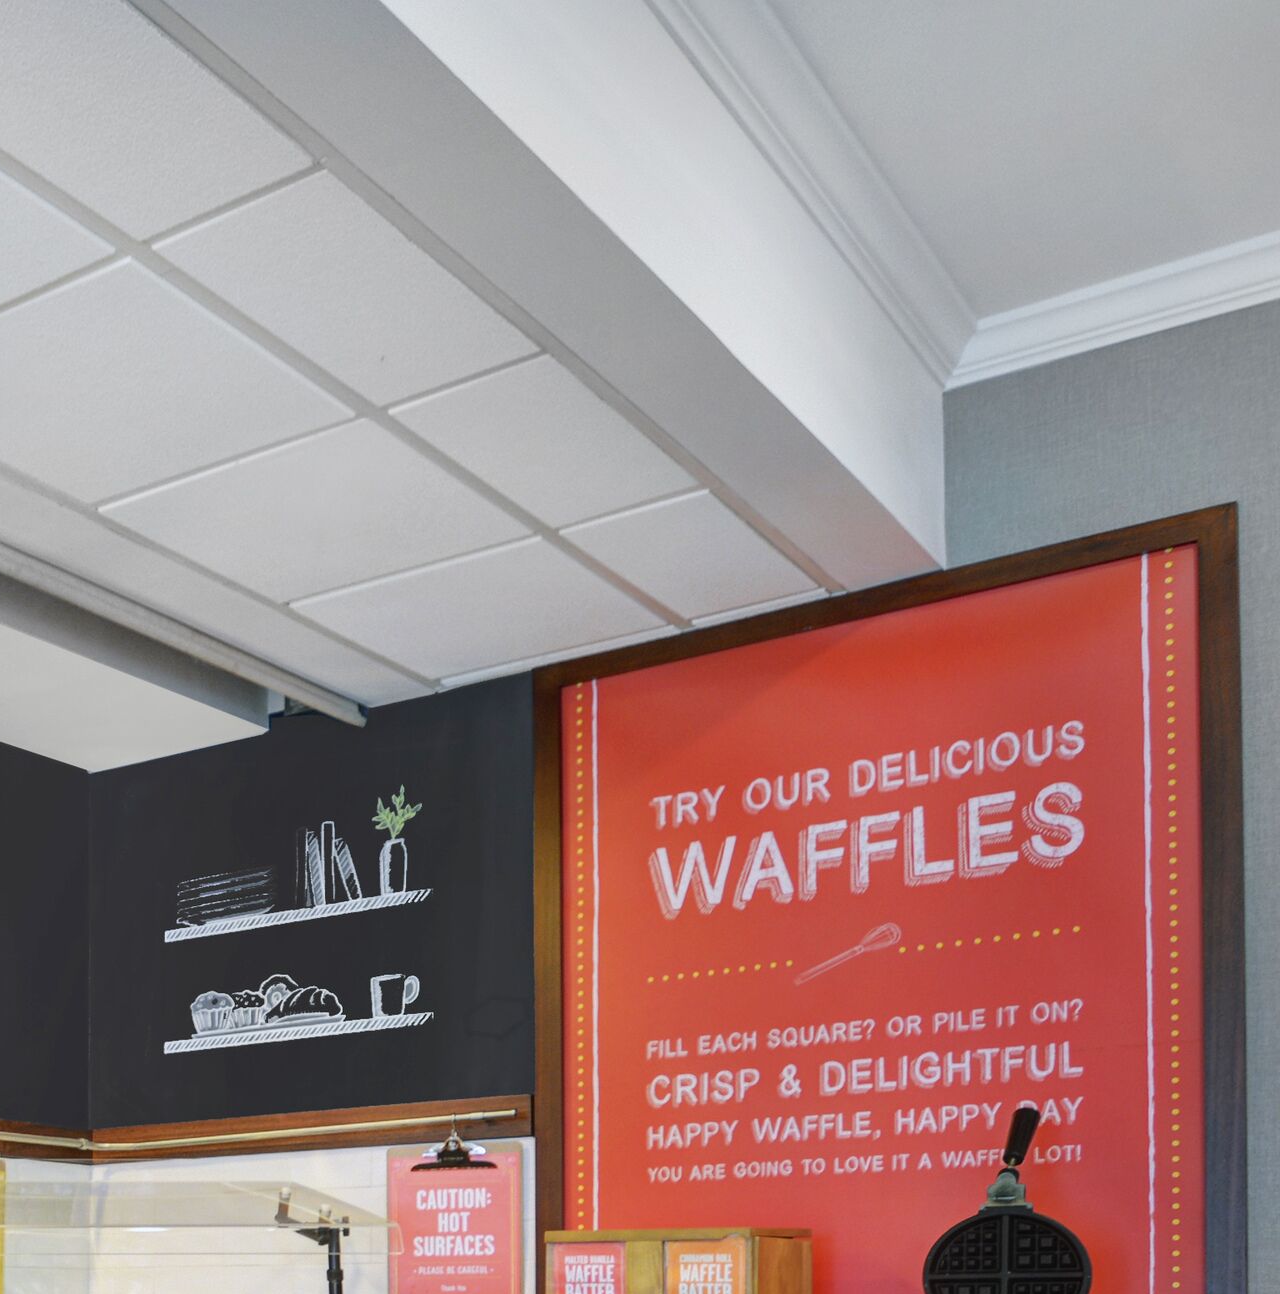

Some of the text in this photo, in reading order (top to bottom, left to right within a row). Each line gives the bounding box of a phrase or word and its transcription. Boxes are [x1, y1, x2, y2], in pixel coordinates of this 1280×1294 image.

[649, 720, 1085, 829] TRY OUR DELICIOUS
[648, 782, 1086, 920] WAFFLES
[646, 998, 1083, 1060] FILL EACH SQUARE? OR PILE IT ON?
[646, 1041, 1084, 1108] CRISP & DELIGHTFUL
[646, 1119, 739, 1150] HAPPY
[751, 1109, 881, 1143] WAFFLE,
[895, 1102, 1002, 1135] HAPPY
[647, 1144, 1082, 1183] YOU ARE GOING TO LOVE IT A WAFF LOT!
[416, 1188, 493, 1210] CAUTION:
[437, 1212, 470, 1233] HOT
[413, 1235, 495, 1257] SURFACES
[418, 1265, 489, 1275] PLEASE BE CAREFUL
[565, 1264, 615, 1282] WAFFLE
[680, 1264, 733, 1282] WAFFLE
